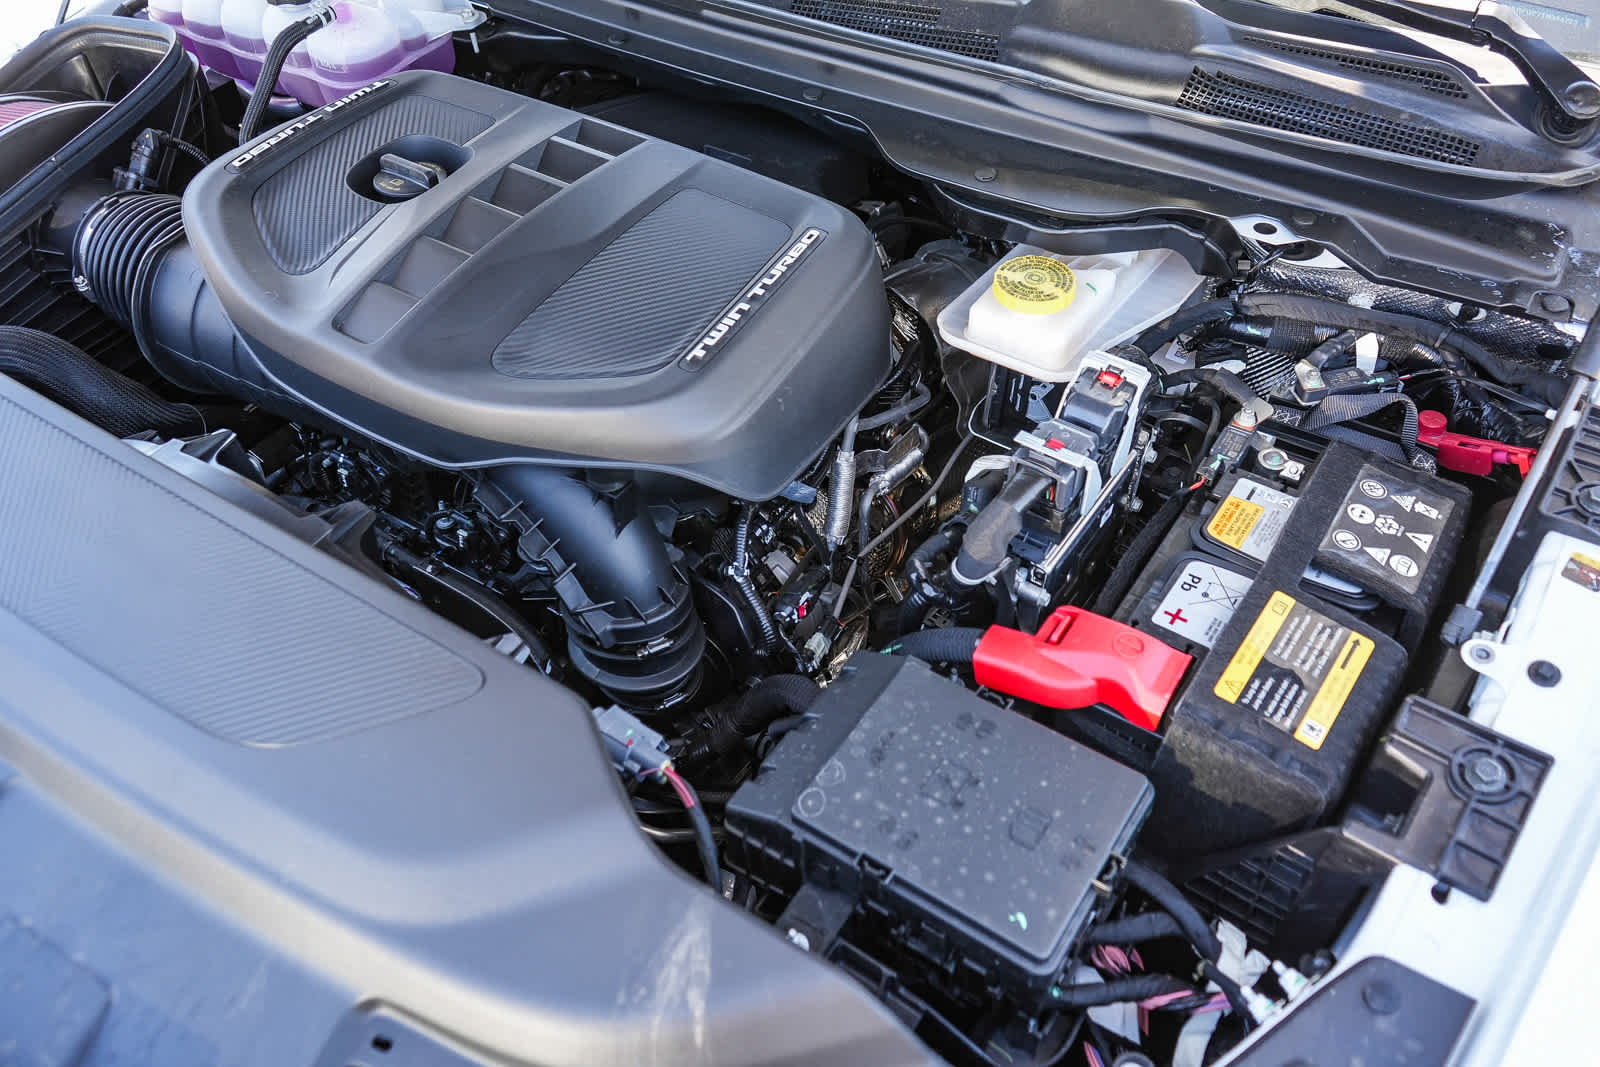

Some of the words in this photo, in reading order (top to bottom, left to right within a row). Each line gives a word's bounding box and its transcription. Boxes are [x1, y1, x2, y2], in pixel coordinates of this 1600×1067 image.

[324, 80, 390, 112] TWIN
[231, 114, 324, 167] TURBO
[685, 301, 751, 361] TWIN
[746, 229, 820, 298] TURBO
[1181, 573, 1202, 592] Pb
